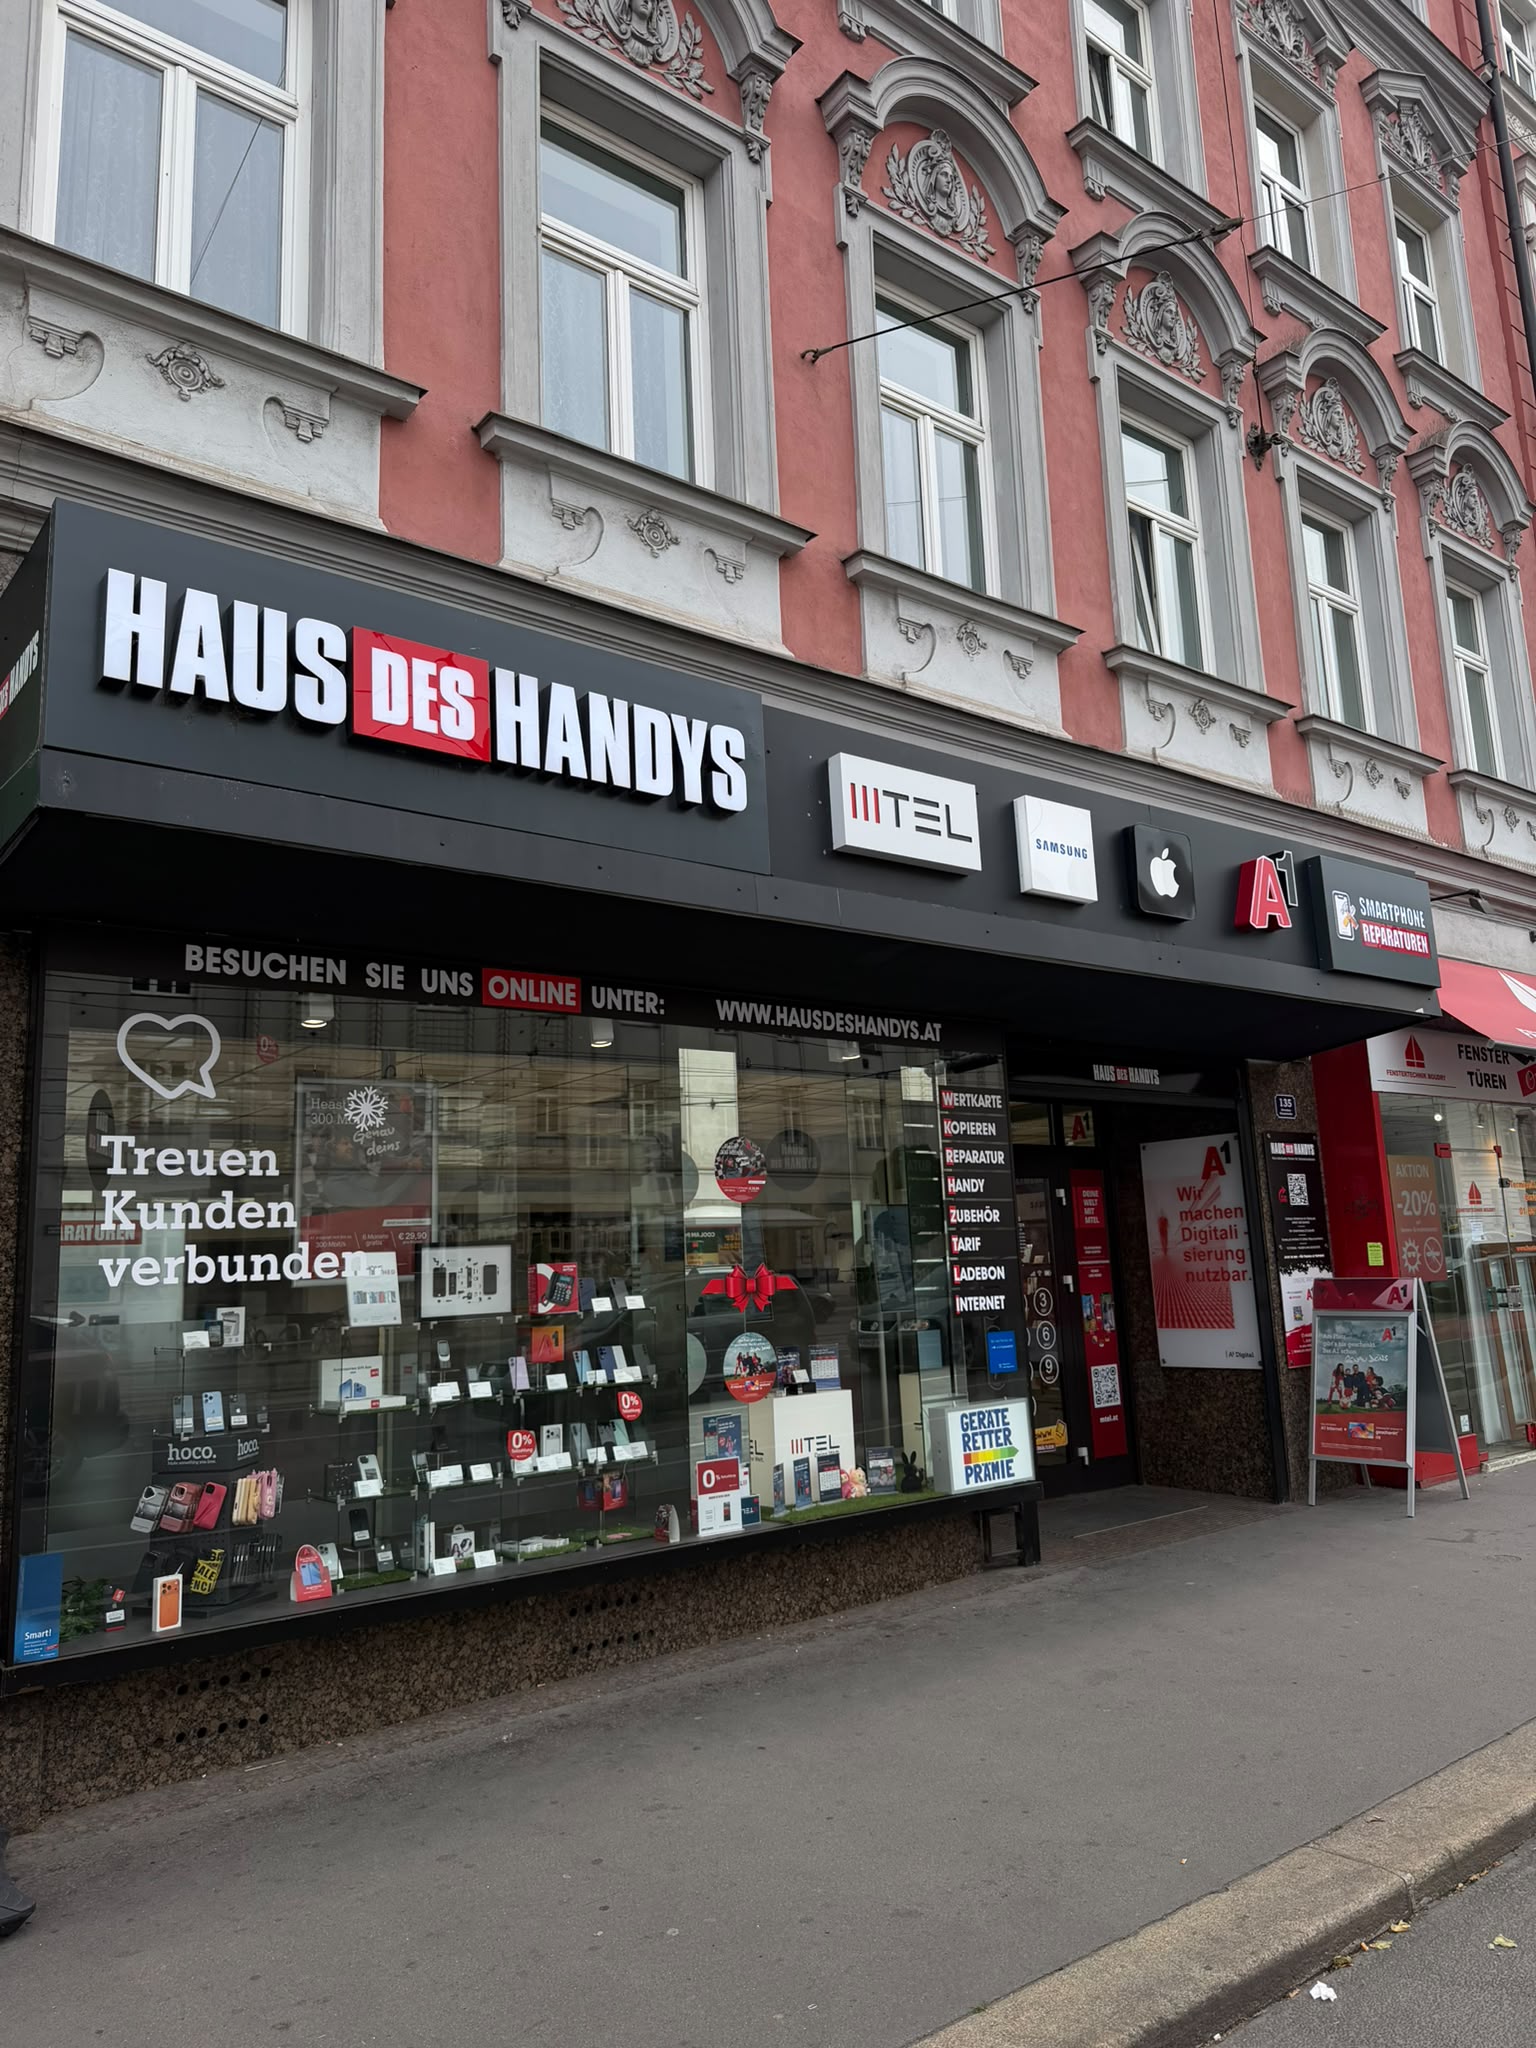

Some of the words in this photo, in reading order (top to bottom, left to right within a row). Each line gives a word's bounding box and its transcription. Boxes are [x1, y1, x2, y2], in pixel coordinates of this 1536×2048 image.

[103, 567, 347, 726] HAUS
[371, 646, 476, 742] DES
[494, 667, 748, 812] HANDYS
[1035, 837, 1089, 861] SAMSUNG
[1249, 850, 1299, 929] A1
[1358, 896, 1426, 929] SMARTPHONE
[1361, 923, 1429, 954] REPARATUREN
[184, 944, 348, 985] BESUCHEN
[365, 962, 405, 991] SIE
[420, 968, 474, 997] UNS
[487, 975, 578, 1007] ONLINE
[591, 985, 665, 1015] UNTER:
[715, 1000, 942, 1043] WWW.HAUSDESHANDYS.AT
[1456, 1043, 1511, 1066] FENSTER
[1092, 1064, 1116, 1082] HAUS
[1115, 1068, 1128, 1081] DES
[1127, 1066, 1160, 1085] HANDYS
[1466, 1068, 1508, 1090] TÜREN
[941, 1090, 1003, 1110] WERTKARTE
[1278, 1097, 1293, 1108] 135
[943, 1118, 997, 1137] KOPIEREN
[1072, 1111, 1090, 1141] A1
[100, 1135, 280, 1178] Treuen
[945, 1148, 1005, 1165] REPARATUR
[1201, 1141, 1231, 1180] A1
[1395, 1164, 1430, 1178] AKTION
[947, 1176, 985, 1194] HANDY
[1176, 1186, 1203, 1203] Wir
[100, 1190, 298, 1233] Kunden
[1396, 1189, 1437, 1217] -20%
[949, 1206, 1001, 1224] ZUBEHÖR
[1179, 1205, 1244, 1222] machen
[951, 1236, 982, 1253] TARIF
[98, 1242, 373, 1288] verbunden
[1183, 1247, 1246, 1265] sierung
[953, 1265, 1005, 1282] LADEBON
[1185, 1266, 1252, 1284] nutzbar.
[1039, 1292, 1047, 1308] 3
[1387, 1284, 1408, 1304] A1
[955, 1295, 1006, 1314] INTERNET
[1042, 1326, 1050, 1342] 6
[1381, 1326, 1396, 1342] A1
[1045, 1358, 1053, 1374] 9
[621, 1393, 640, 1409] 0%
[959, 1407, 1010, 1433] GERÄTE
[511, 1431, 533, 1449] 0%
[961, 1427, 1013, 1453] RETTER
[167, 1443, 217, 1461] hoco.
[964, 1458, 1016, 1486] PRÄMIE
[24, 1628, 52, 1641] Smart!
